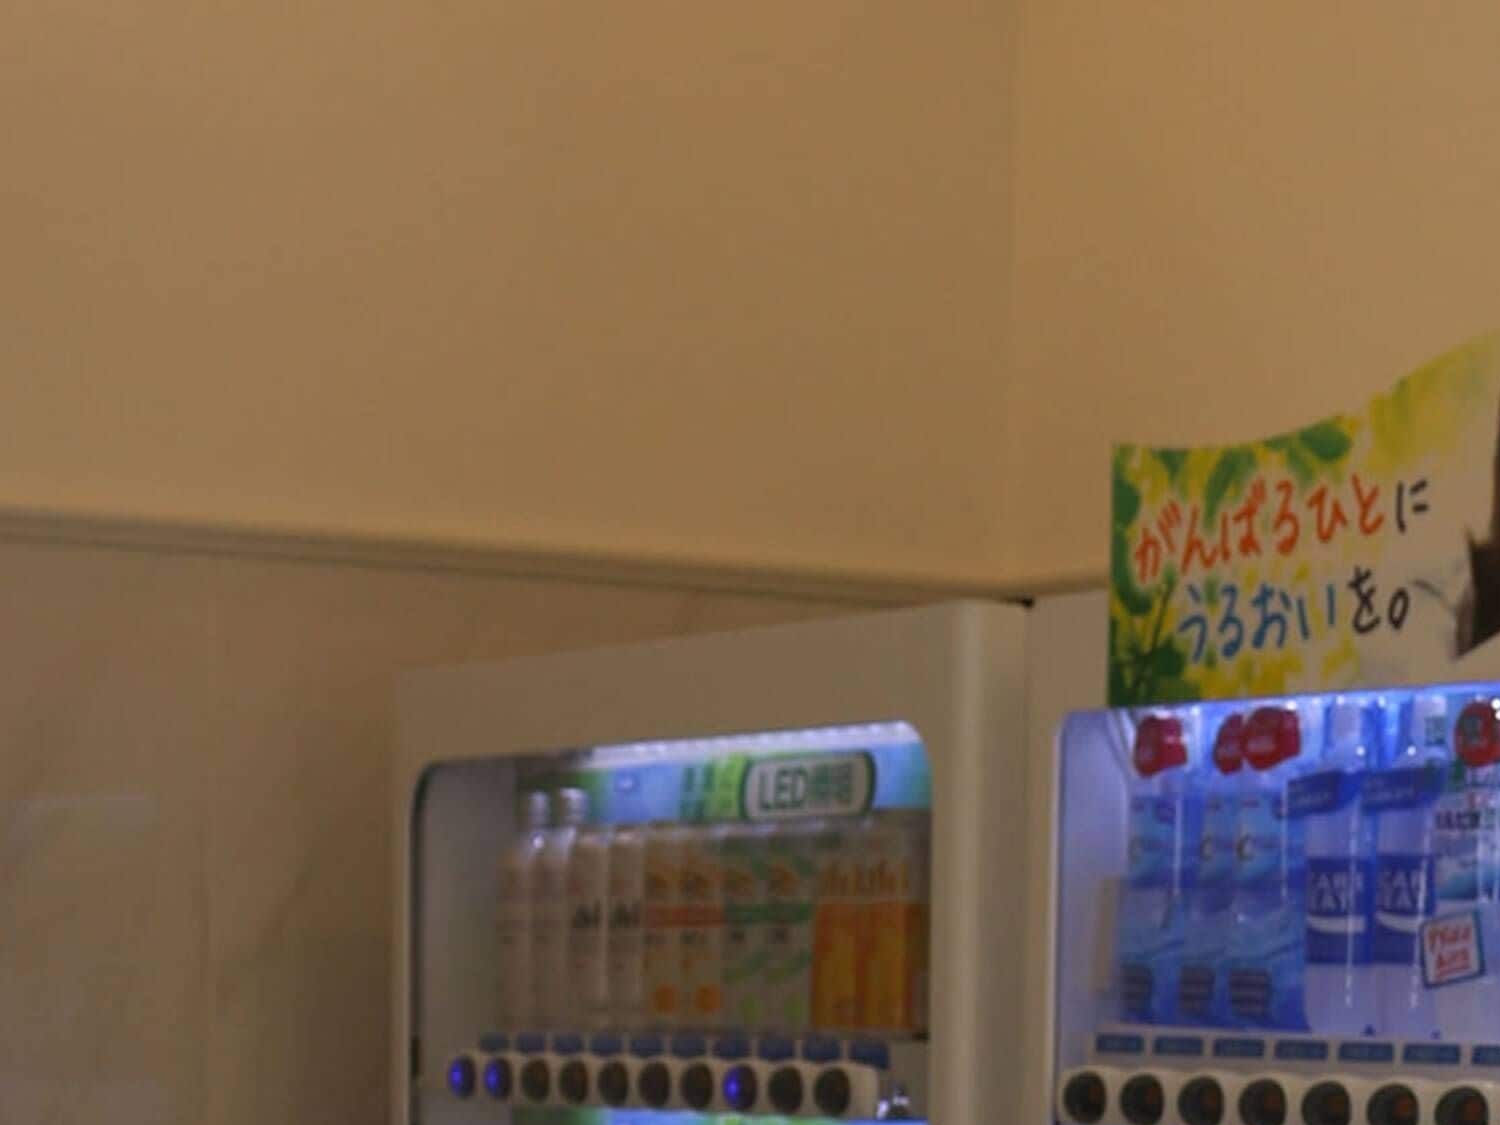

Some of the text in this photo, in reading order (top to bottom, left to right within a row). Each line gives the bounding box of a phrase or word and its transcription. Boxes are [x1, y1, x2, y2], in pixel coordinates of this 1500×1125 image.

[1134, 474, 1432, 583] がんばるひとに
[1178, 565, 1411, 660] うるおいを。
